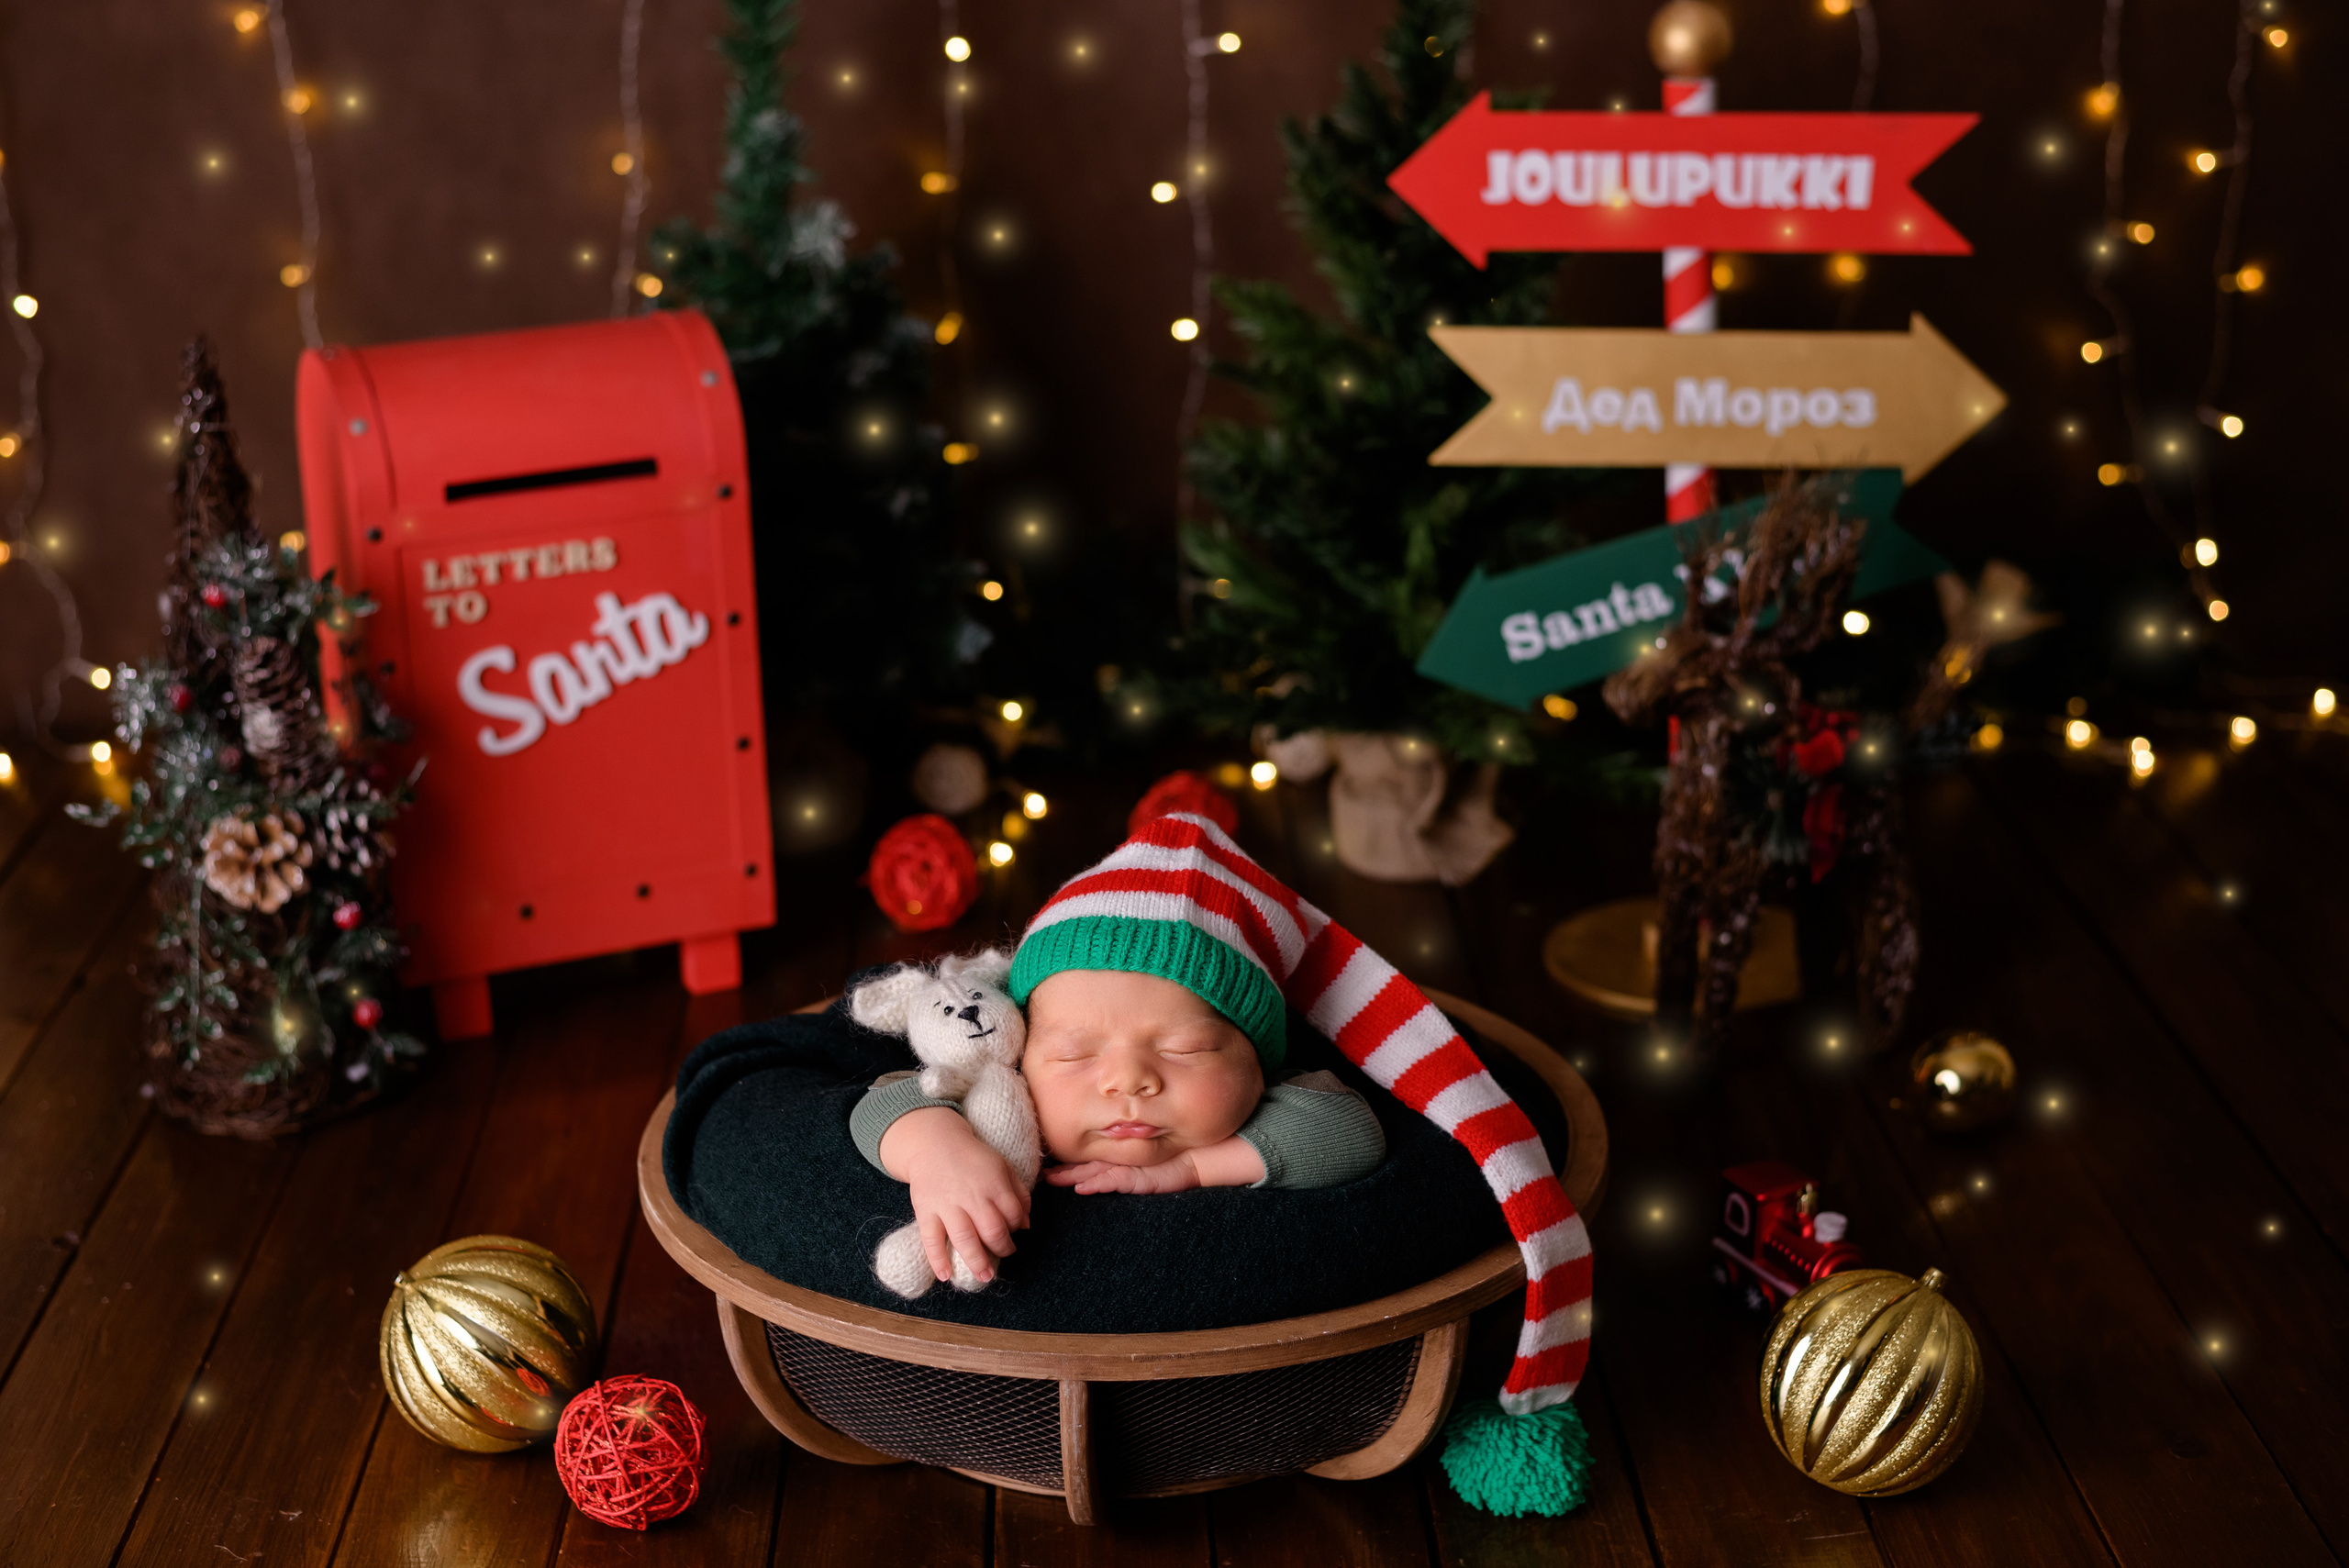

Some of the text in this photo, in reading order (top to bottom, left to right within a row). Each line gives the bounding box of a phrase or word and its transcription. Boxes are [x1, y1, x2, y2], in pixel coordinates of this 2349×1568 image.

[1481, 150, 1875, 210] JOULUPUKKI
[1542, 377, 1877, 436] Дед Мороз
[424, 537, 618, 592] LETTERS
[425, 591, 488, 628] TO
[1501, 582, 1674, 662] Santa
[458, 592, 709, 757] Santa
